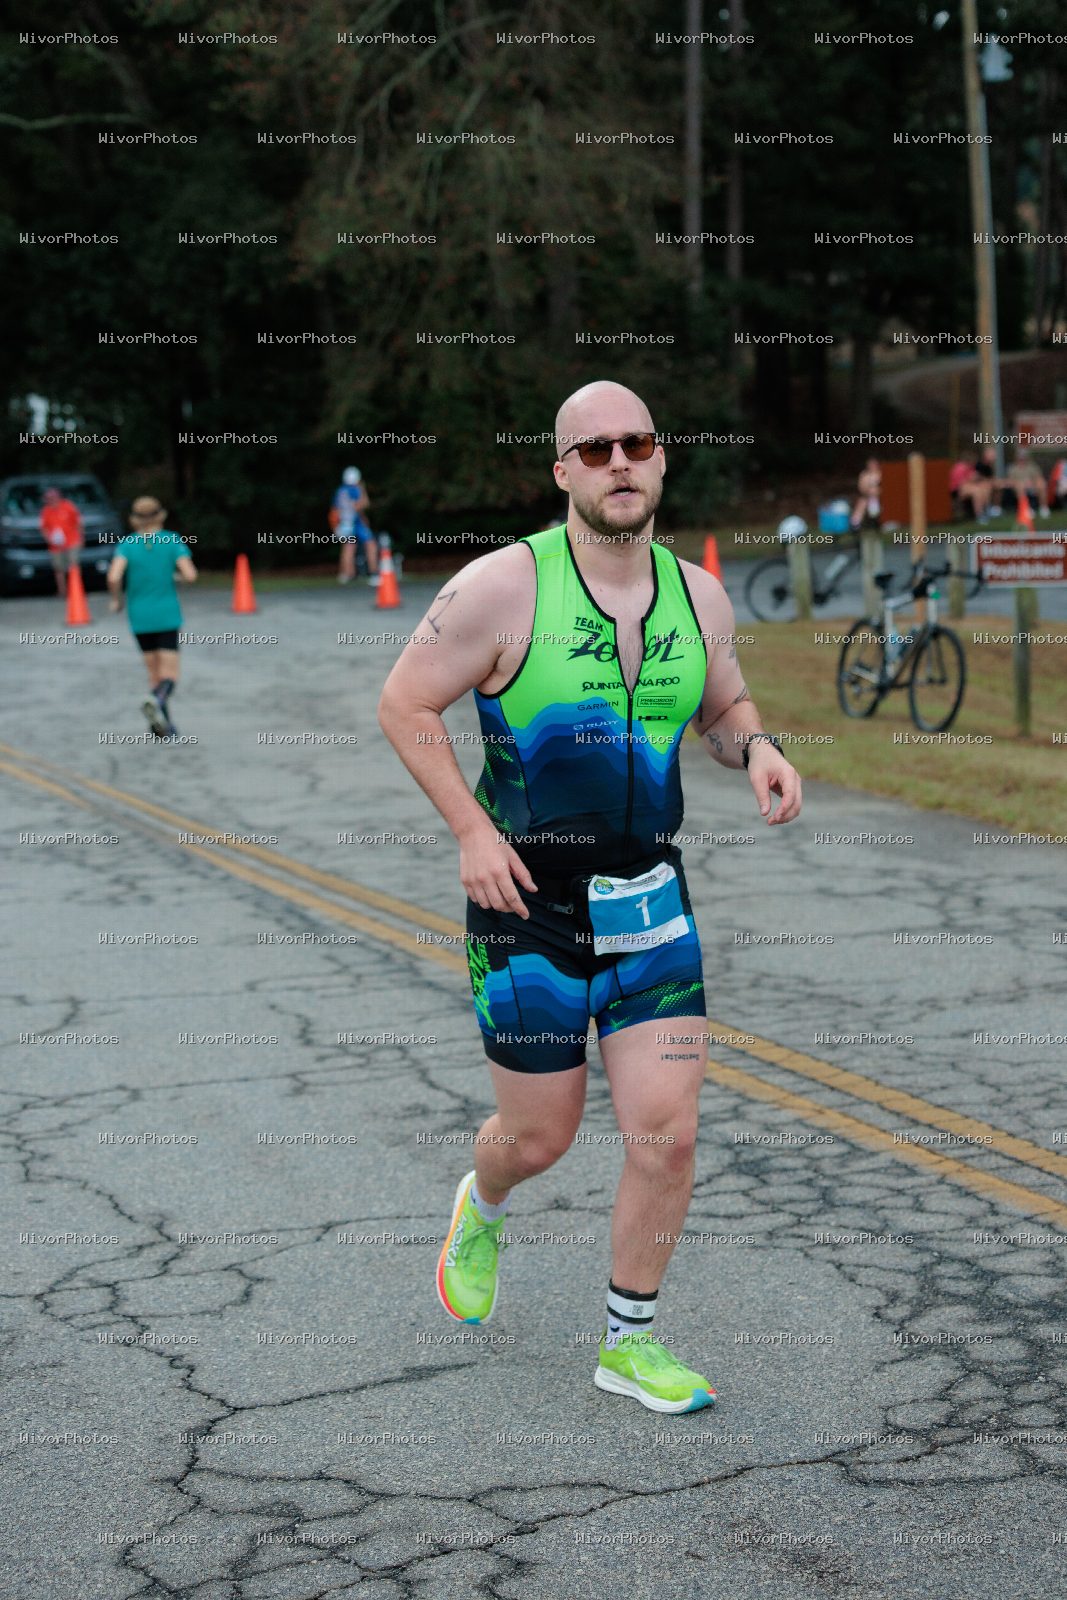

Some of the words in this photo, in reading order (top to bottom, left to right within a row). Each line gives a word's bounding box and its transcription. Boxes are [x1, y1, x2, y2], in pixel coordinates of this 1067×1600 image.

[574, 616, 604, 632] TEAM
[577, 700, 619, 711] GARMIN
[586, 719, 619, 728] RUDY
[635, 895, 651, 927] 1
[479, 943, 492, 973] TEAM
